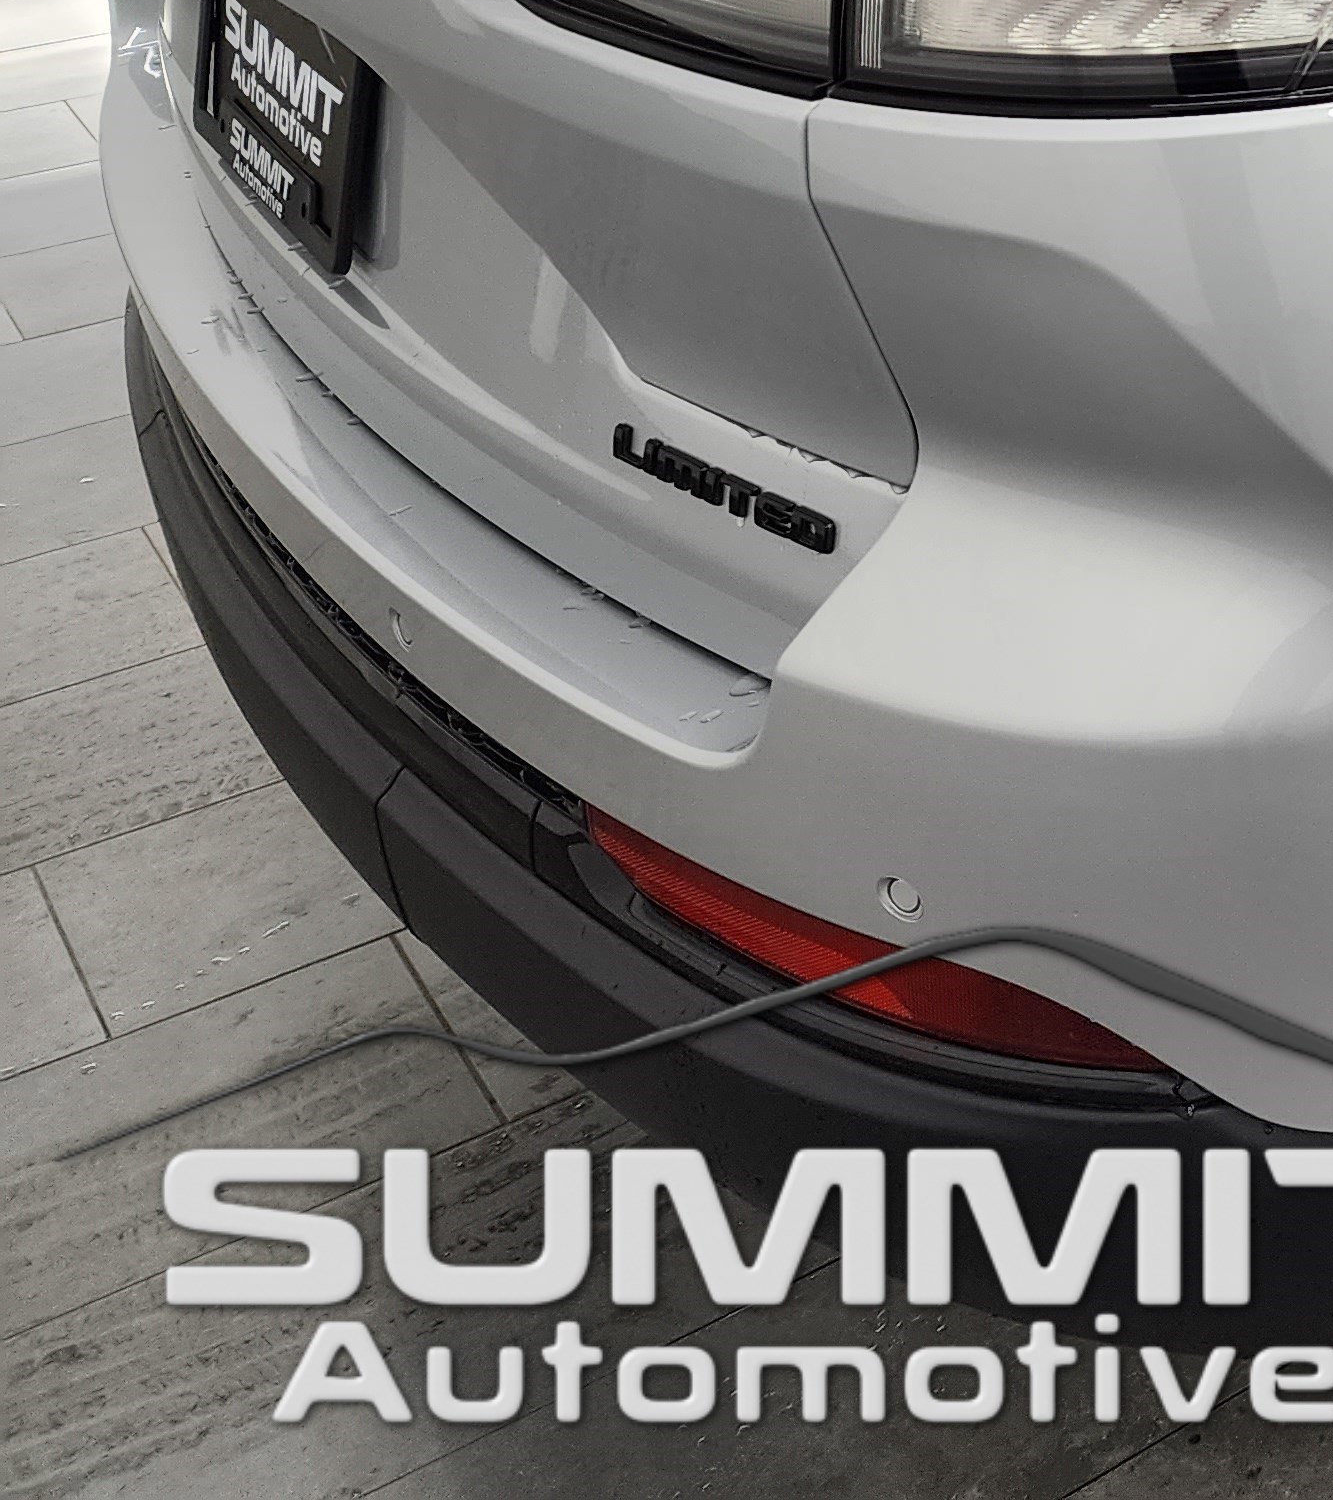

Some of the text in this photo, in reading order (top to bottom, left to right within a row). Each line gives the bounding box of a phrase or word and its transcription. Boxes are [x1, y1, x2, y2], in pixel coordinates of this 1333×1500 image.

[229, 118, 296, 200] SUMMIT
[230, 52, 323, 168] Automotive
[232, 153, 284, 220] Automotive
[612, 423, 836, 554] LIMITED
